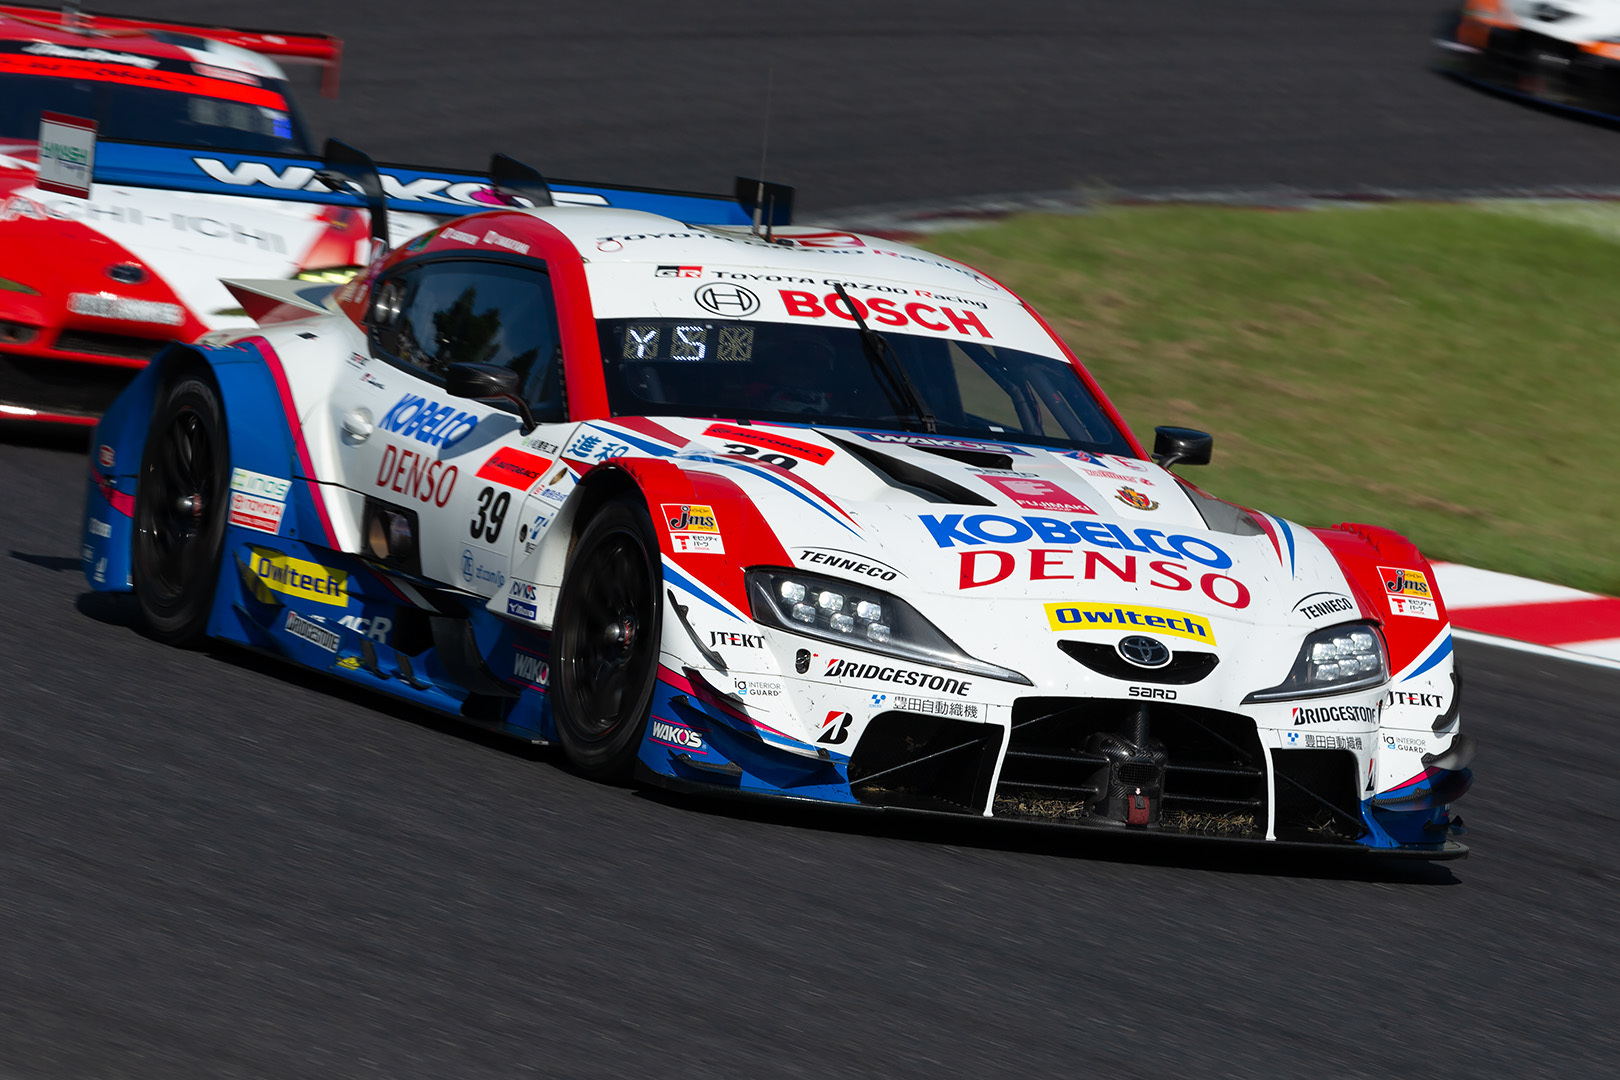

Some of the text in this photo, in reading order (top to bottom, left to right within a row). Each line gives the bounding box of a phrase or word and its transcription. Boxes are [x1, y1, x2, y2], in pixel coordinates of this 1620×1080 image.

[711, 271, 816, 285] TOYOTA
[823, 279, 908, 295] GAZOO
[914, 289, 988, 309] Racing
[778, 289, 994, 339] BOSCH
[378, 393, 478, 450] KOBELCO
[376, 444, 458, 508] DENSO
[470, 486, 511, 544] 39
[1015, 499, 1091, 511] FUJIMAKI
[917, 514, 1234, 570] KOBELCO
[257, 558, 341, 597] Owltech
[799, 550, 898, 582] TENNECO
[957, 548, 1252, 610] DENSO
[1055, 607, 1206, 637] Owltech
[1299, 597, 1354, 620] TENNECO
[710, 631, 766, 650] JTEKT
[513, 652, 550, 686] WAKO
[824, 658, 972, 697] BRIDGESTONE
[749, 682, 781, 690] INTERIOR
[1388, 690, 1444, 709] JTEKT
[1292, 706, 1376, 726] BRIDGESTONE
[652, 720, 703, 748] WAKO'S
[1396, 737, 1426, 746] INTERIOR
